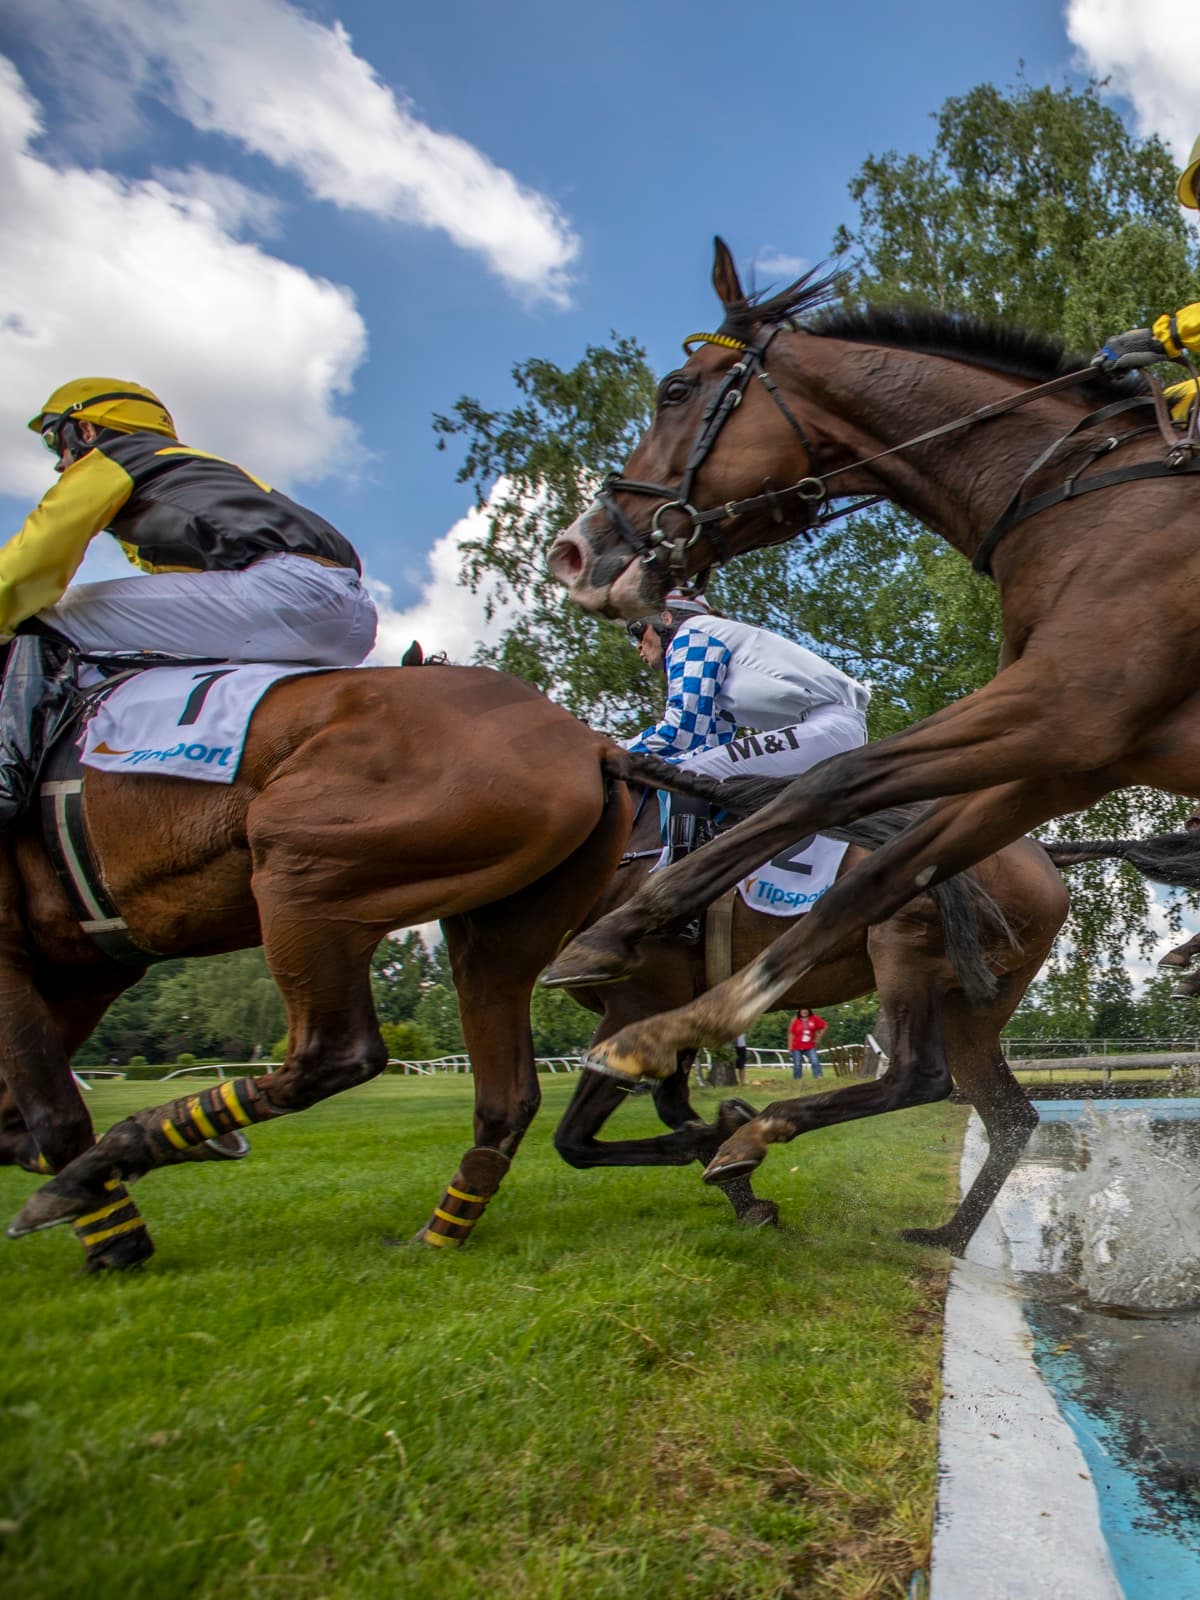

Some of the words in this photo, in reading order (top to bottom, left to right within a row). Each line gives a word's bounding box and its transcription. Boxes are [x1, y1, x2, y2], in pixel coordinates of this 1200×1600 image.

[177, 669, 240, 726] 1
[725, 726, 800, 762] M&T
[758, 881, 829, 908] Tipspo
